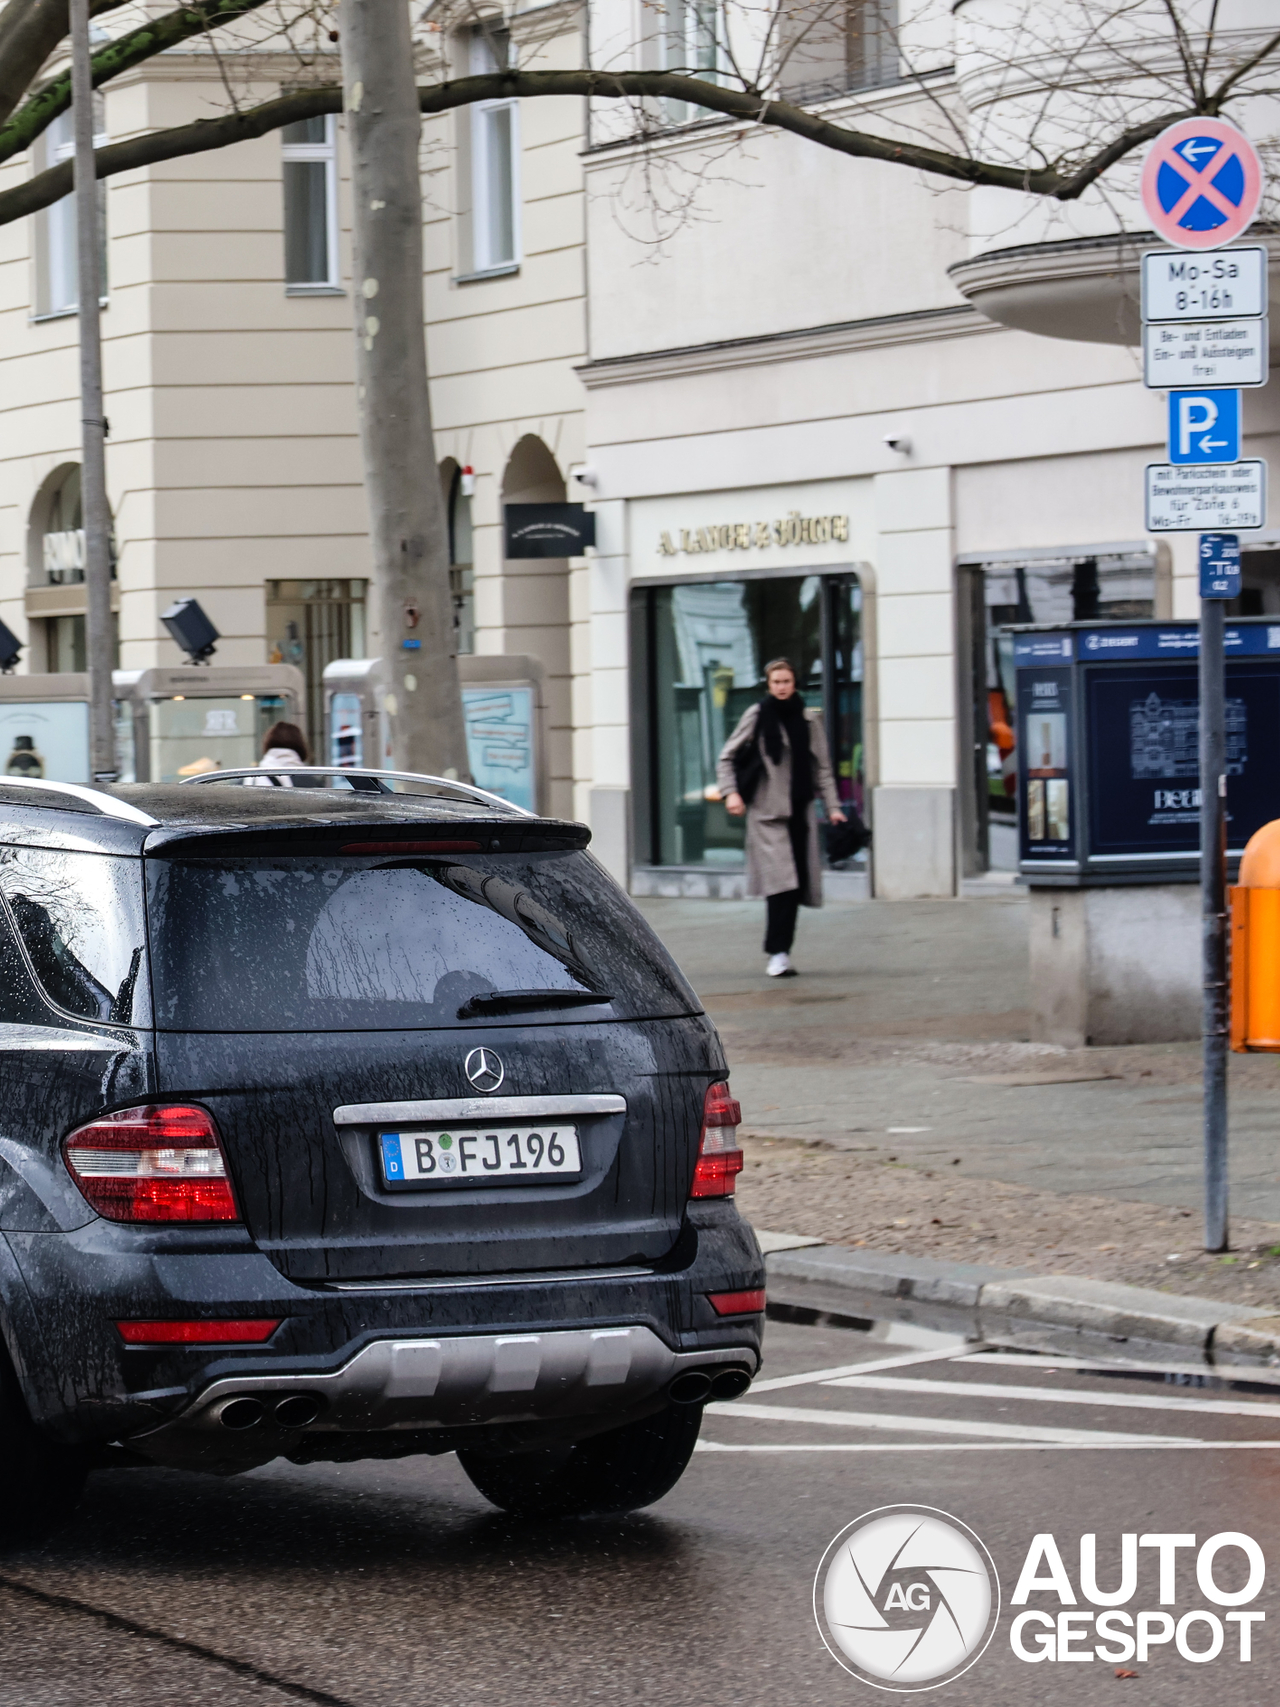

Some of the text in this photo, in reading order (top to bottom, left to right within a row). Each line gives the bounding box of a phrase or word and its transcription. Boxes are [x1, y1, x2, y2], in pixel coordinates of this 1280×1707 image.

[1168, 259, 1239, 281] Mo-Sa
[1175, 289, 1233, 310] 8-16h
[1183, 329, 1201, 341] und
[1205, 328, 1247, 340] Entladen
[1179, 347, 1197, 359] und
[1202, 346, 1255, 360] Aussteigen
[1192, 364, 1217, 376] frei
[1178, 396, 1219, 455] P
[1176, 467, 1228, 480] Parkschein
[1231, 467, 1253, 478] oder
[1171, 500, 1189, 511] für
[1194, 498, 1226, 511] Zone
[679, 523, 750, 554] LANGE
[754, 521, 770, 549] &
[773, 510, 850, 547] SÖHNE
[1207, 561, 1232, 576] T
[390, 1161, 398, 1173] D
[414, 1138, 437, 1173] B
